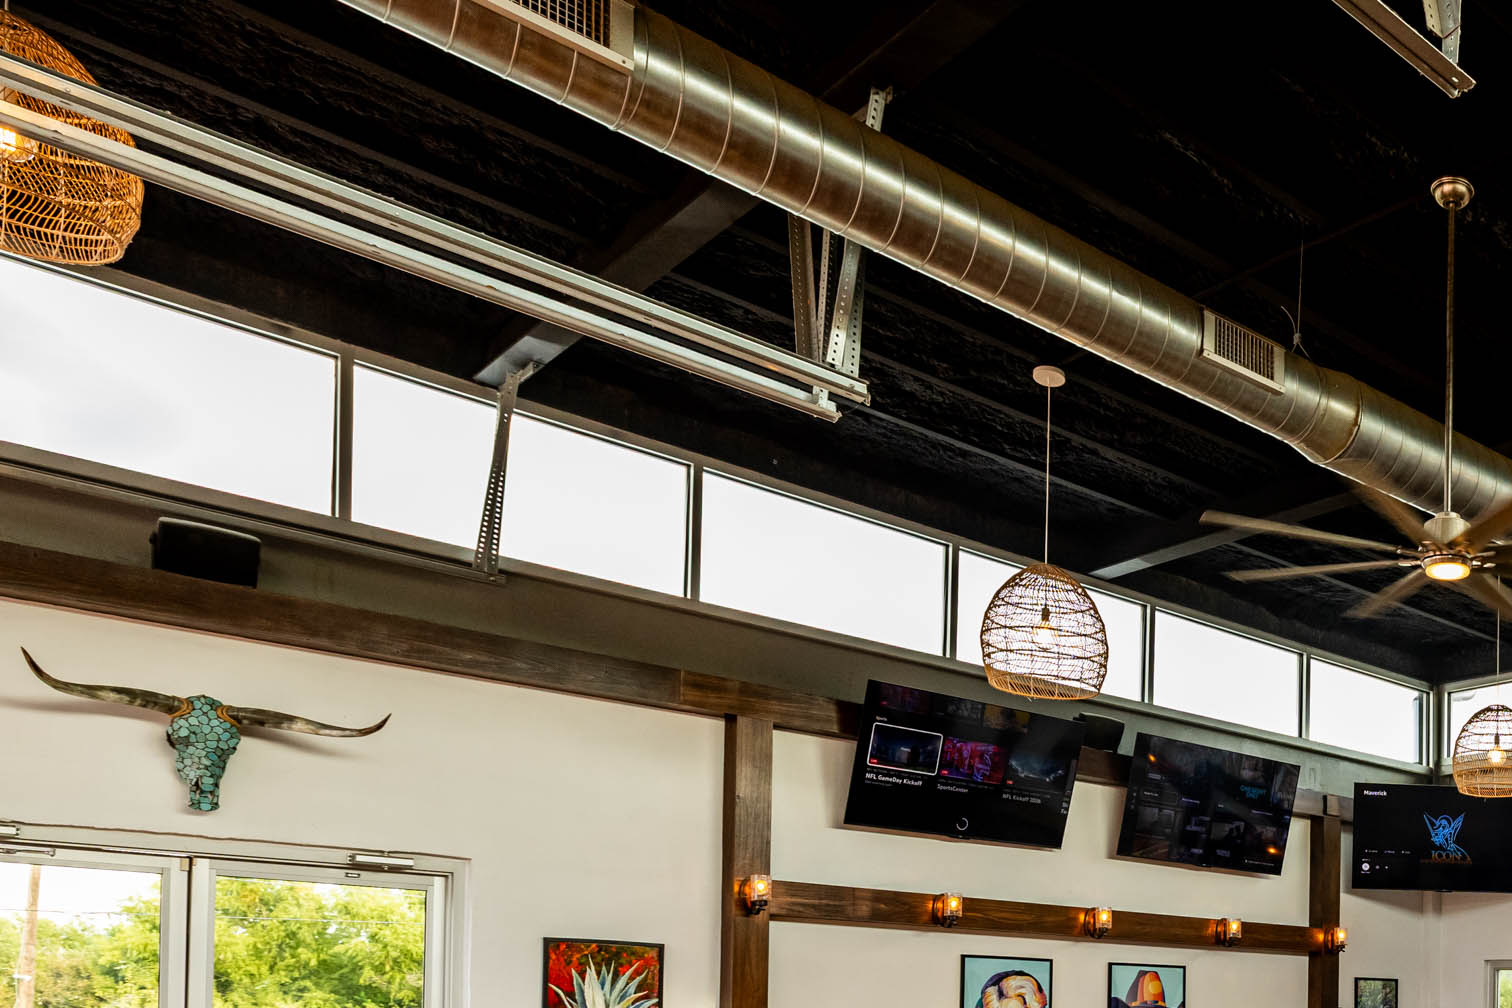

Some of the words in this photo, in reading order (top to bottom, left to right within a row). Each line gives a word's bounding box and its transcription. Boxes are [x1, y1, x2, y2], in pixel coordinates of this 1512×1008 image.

[865, 772, 877, 780] NFL
[878, 774, 902, 784] GameDay
[903, 778, 923, 786] Kickoff
[937, 784, 968, 793] SportsCenter
